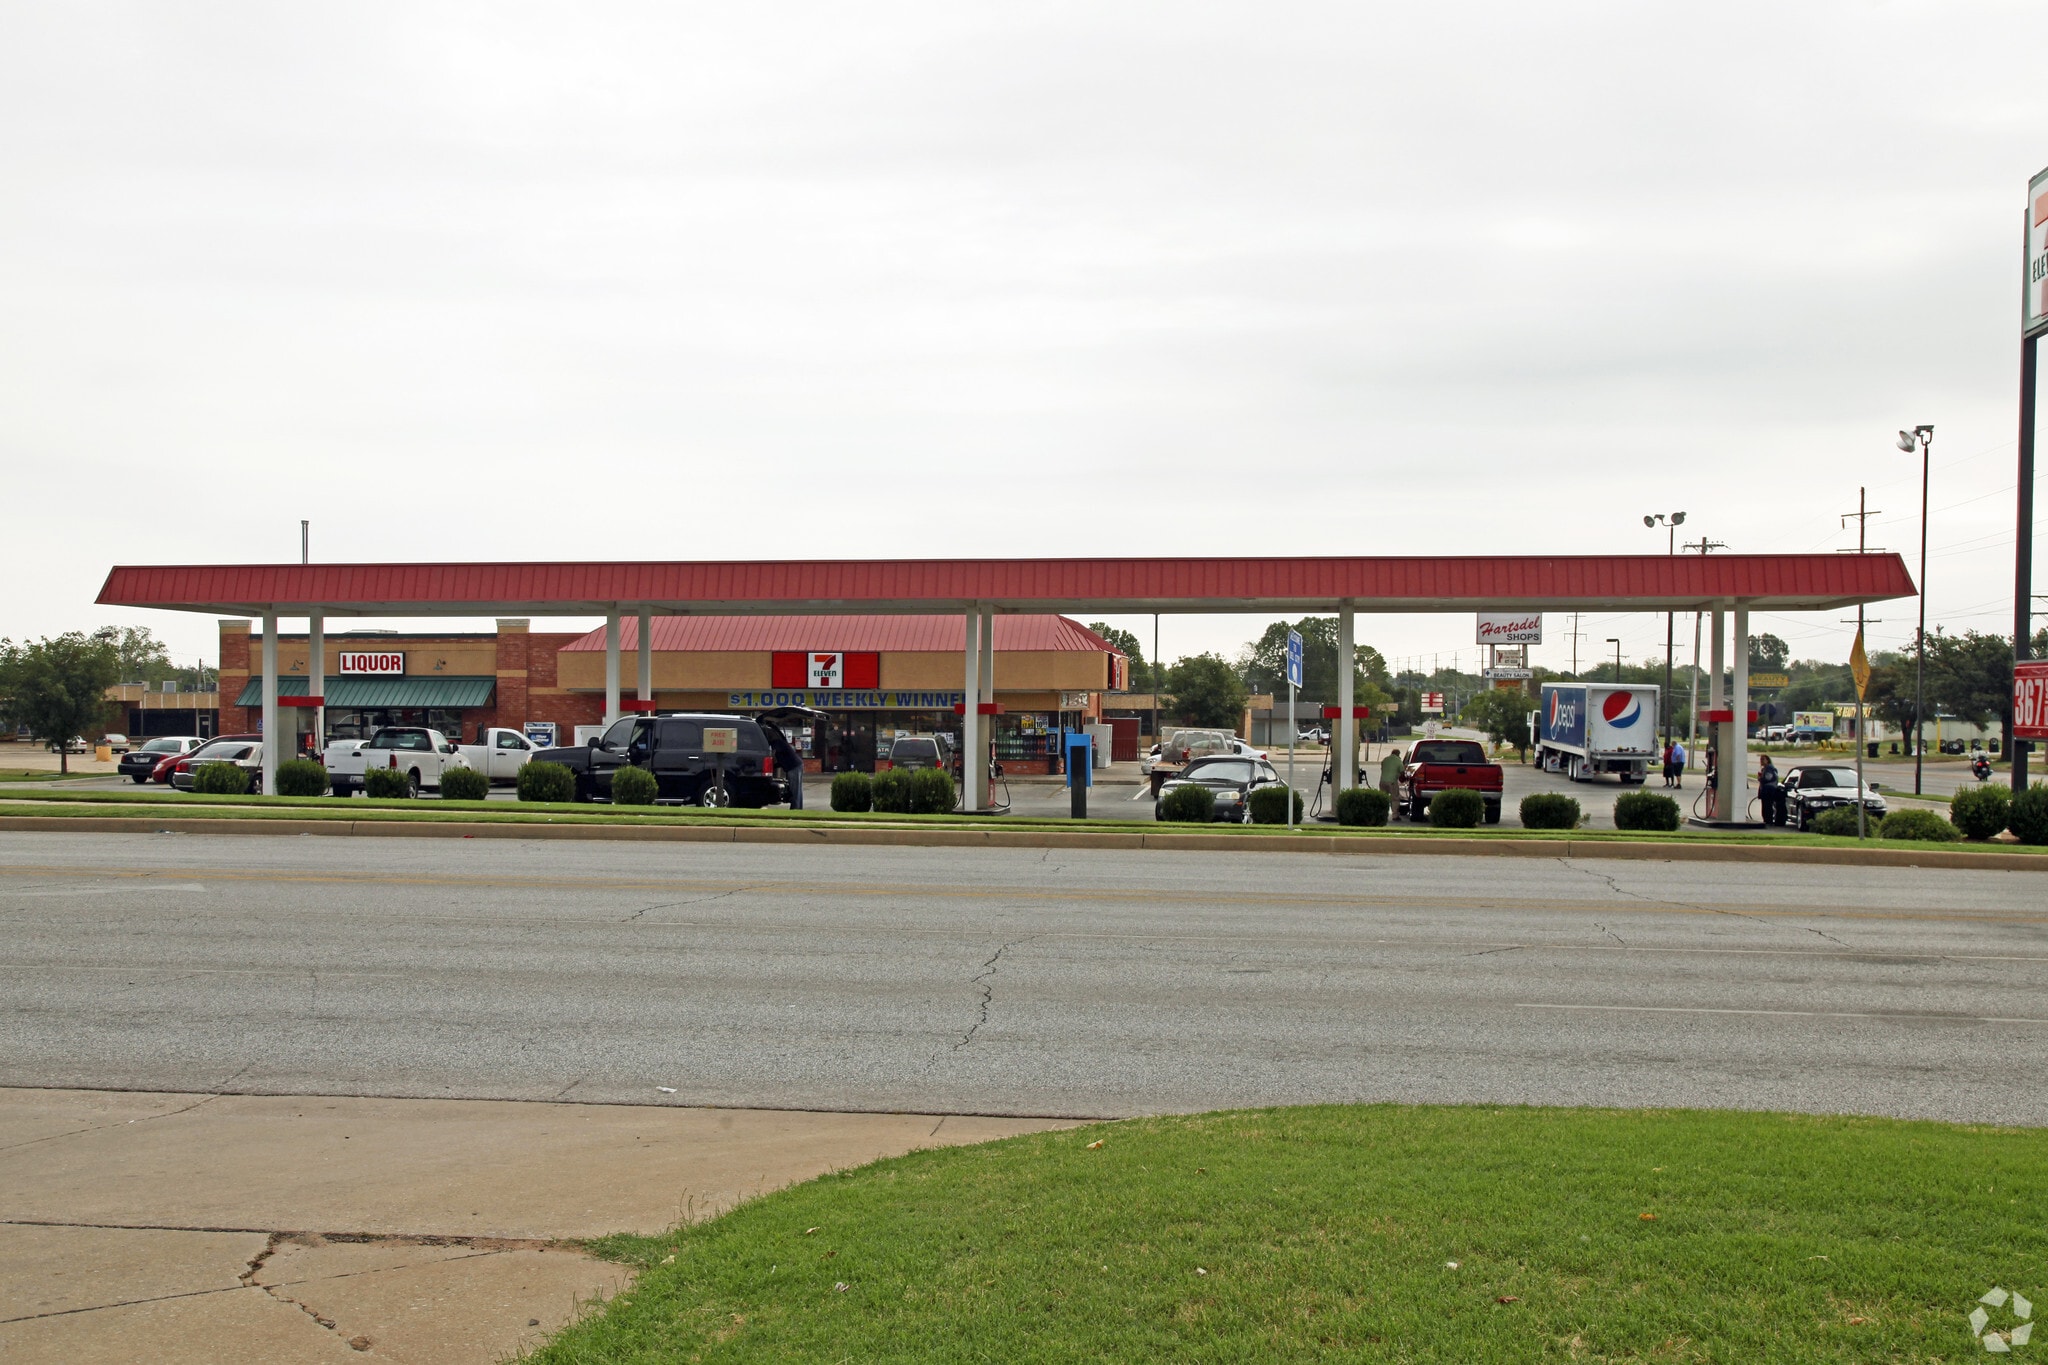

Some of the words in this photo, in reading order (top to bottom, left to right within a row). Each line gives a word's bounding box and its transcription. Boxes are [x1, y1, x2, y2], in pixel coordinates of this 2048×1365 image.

[1480, 616, 1540, 636] Hartsdel
[1507, 633, 1540, 641] SHOPS
[342, 655, 401, 672] LIQUOR
[813, 692, 890, 707] WEEKLY
[2014, 678, 2044, 726] 367
[1558, 699, 1576, 734] pepsi
